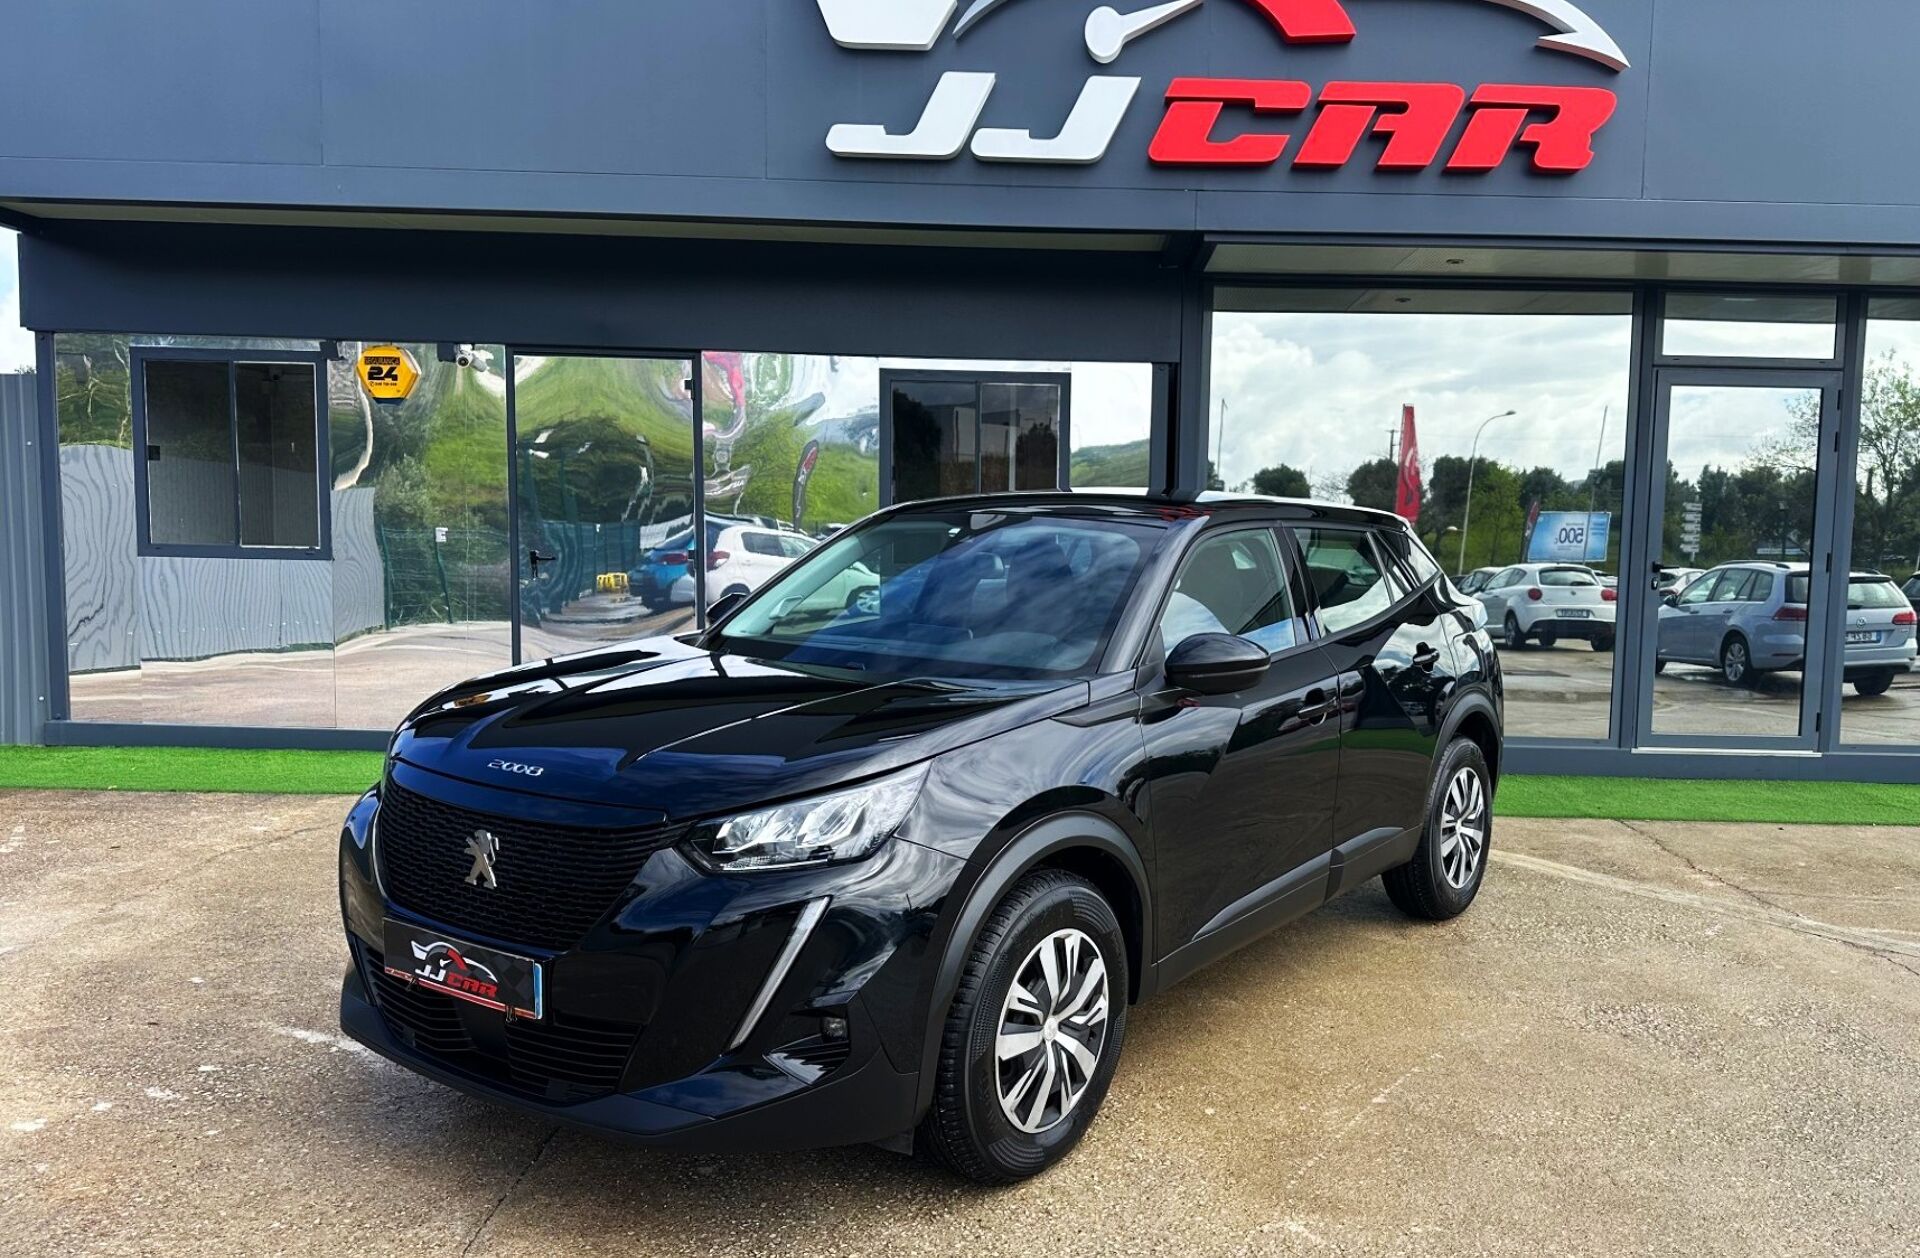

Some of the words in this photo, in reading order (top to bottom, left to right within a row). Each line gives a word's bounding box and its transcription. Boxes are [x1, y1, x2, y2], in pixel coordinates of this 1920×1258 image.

[826, 72, 1141, 164] JJ
[1148, 77, 1617, 173] CAR
[368, 366, 398, 381] 24
[487, 759, 544, 776] 2008
[415, 964, 446, 982] JJ
[447, 972, 498, 998] CAR
